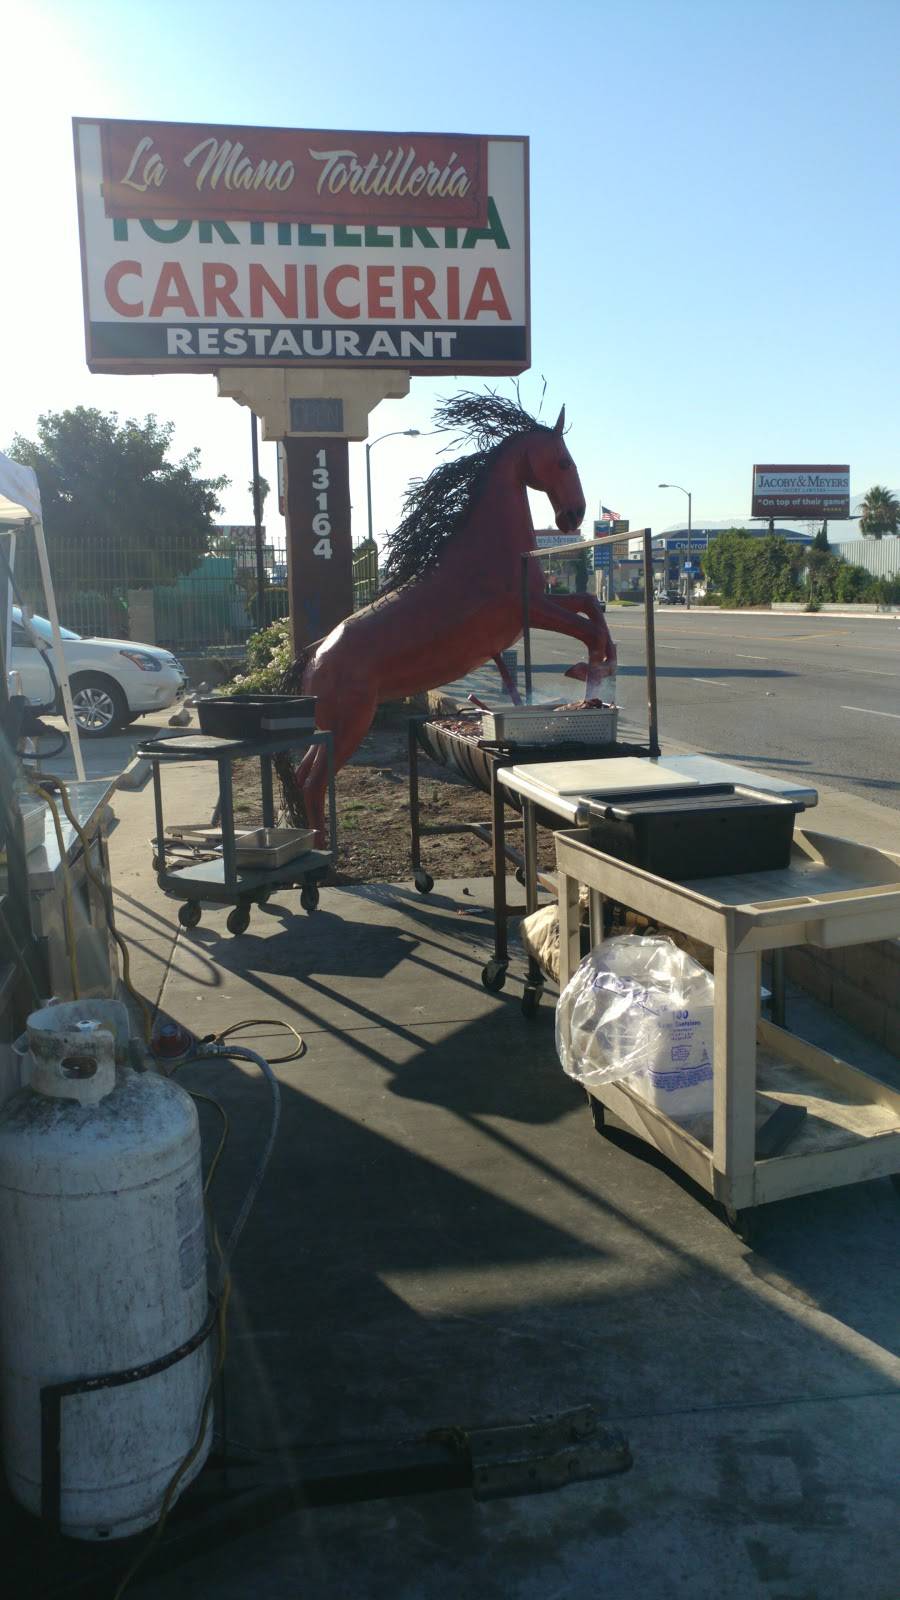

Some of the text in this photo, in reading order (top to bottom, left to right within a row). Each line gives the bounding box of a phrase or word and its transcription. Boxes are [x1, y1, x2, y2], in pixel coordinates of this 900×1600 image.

[121, 136, 168, 192] La
[183, 137, 295, 191] Mano
[104, 259, 513, 321] CARNICERIA
[166, 327, 458, 359] RESTAURANT
[312, 449, 333, 560] 13164
